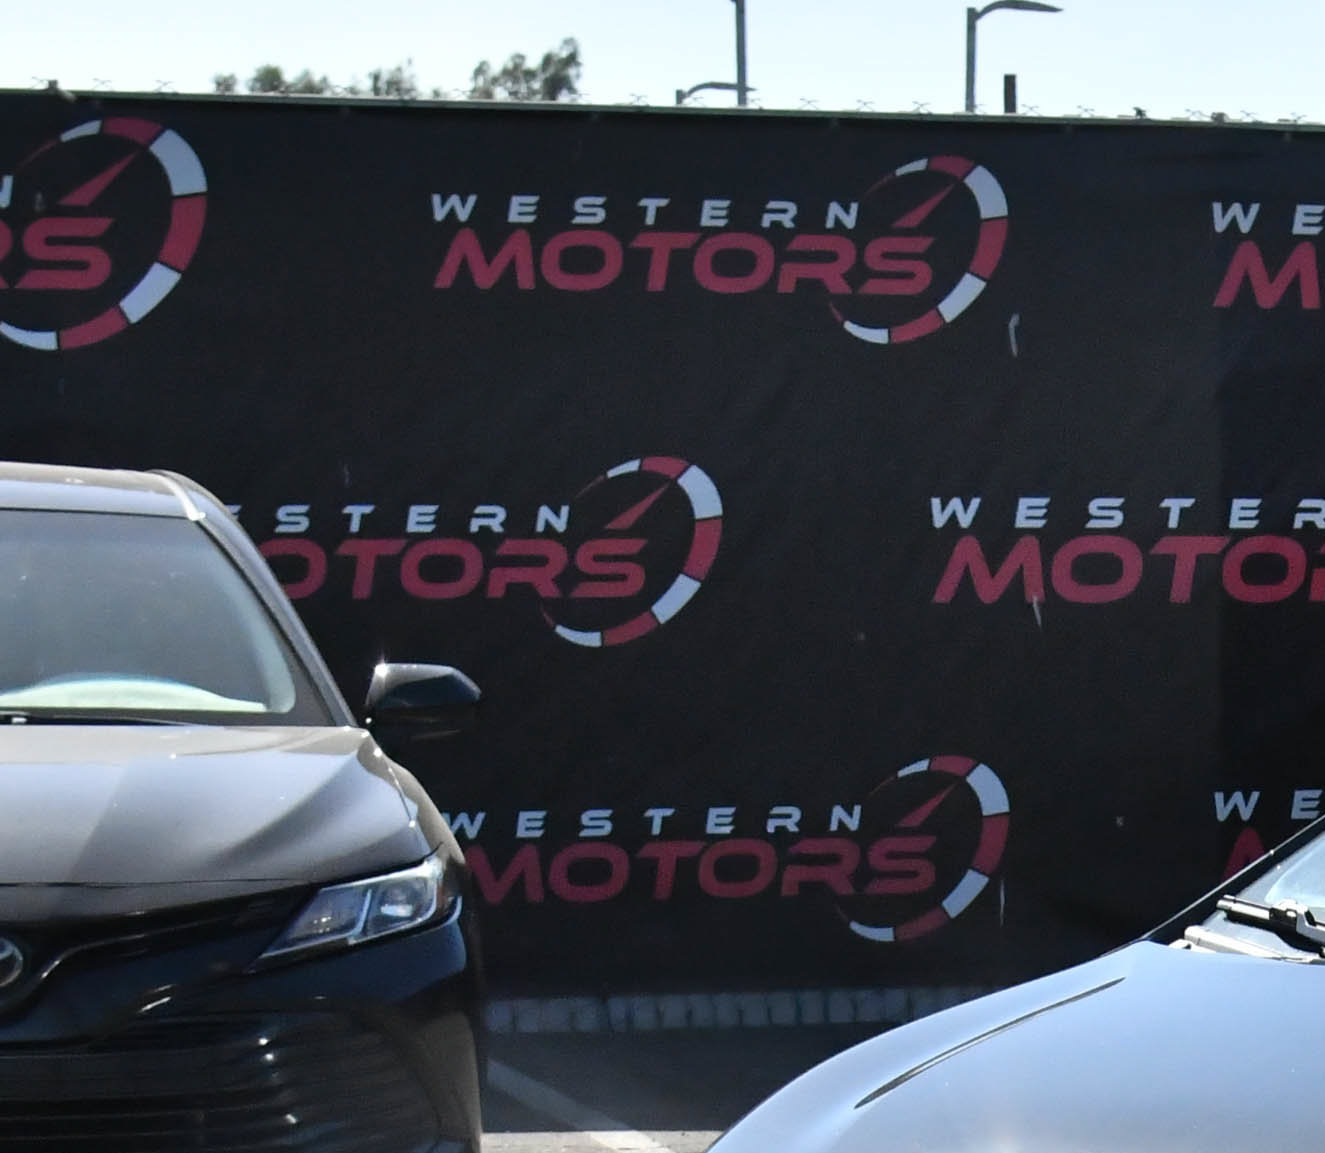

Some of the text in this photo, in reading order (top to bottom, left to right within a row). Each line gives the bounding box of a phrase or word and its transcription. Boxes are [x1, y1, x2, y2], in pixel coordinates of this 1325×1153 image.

[432, 194, 858, 229] WESTERN
[434, 229, 933, 294] MOTORS
[226, 504, 570, 533] STERN
[258, 538, 647, 599] OTORS
[441, 805, 862, 839] WESTERN
[464, 836, 936, 904] MOTORS
